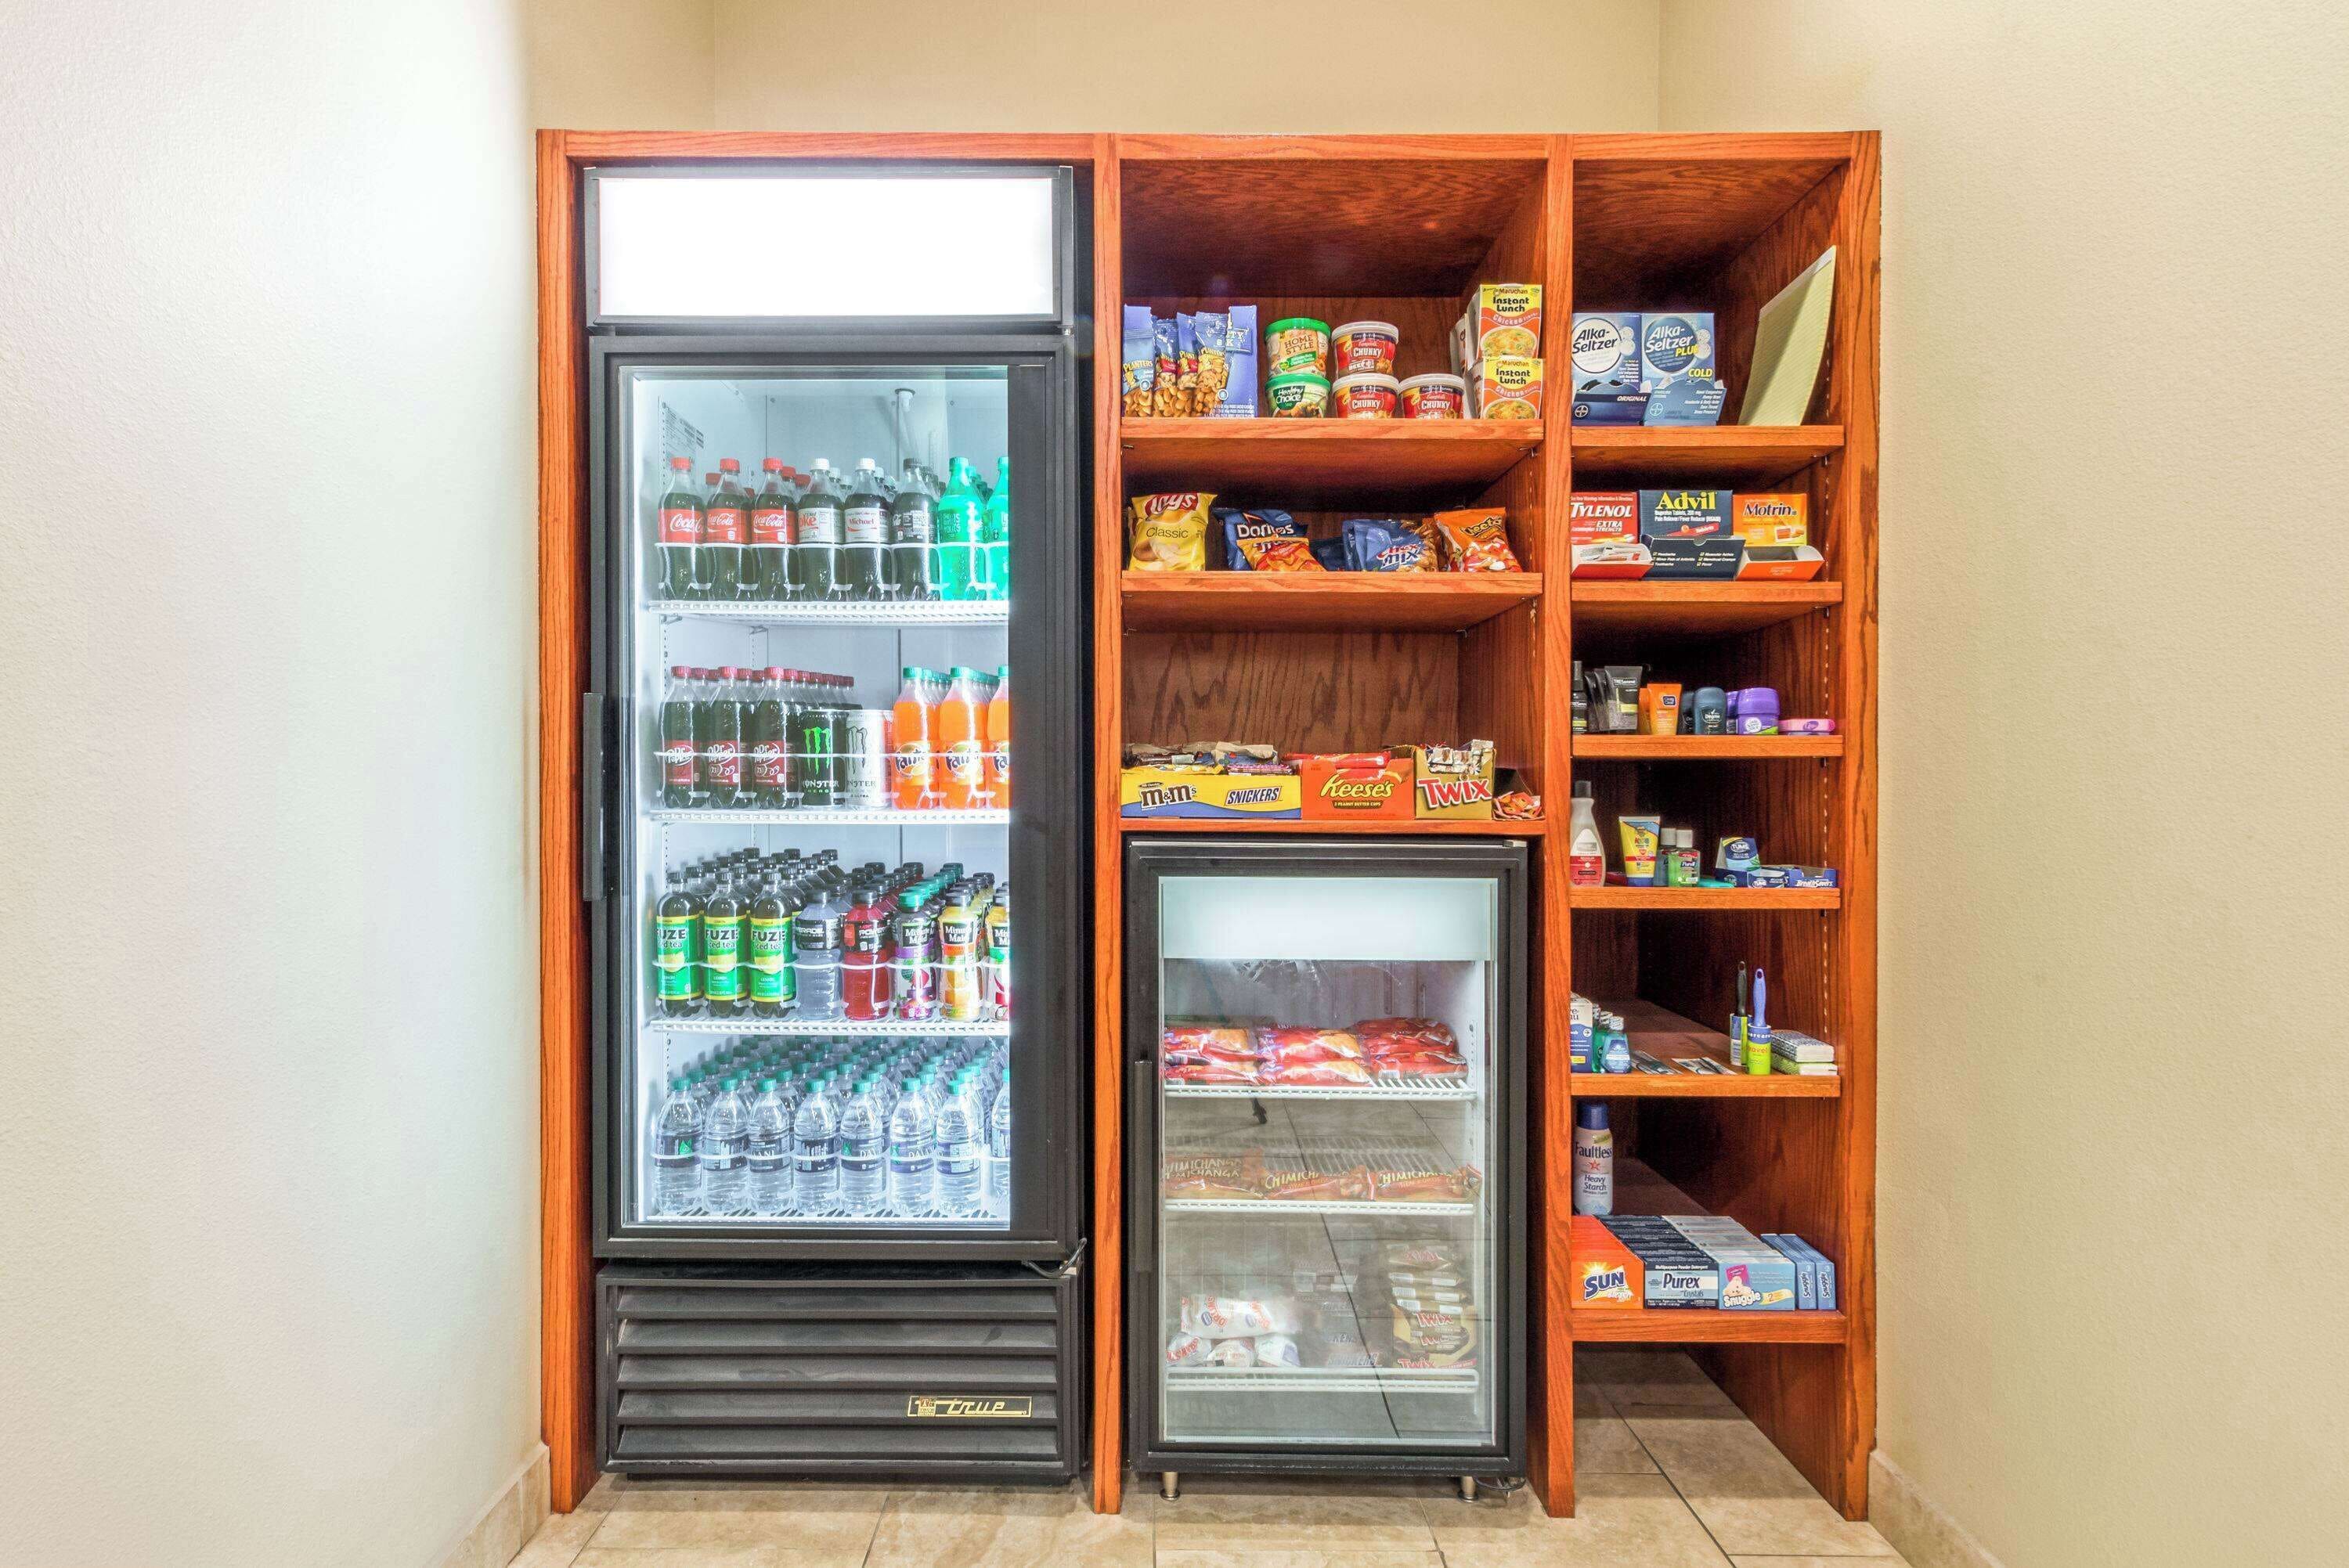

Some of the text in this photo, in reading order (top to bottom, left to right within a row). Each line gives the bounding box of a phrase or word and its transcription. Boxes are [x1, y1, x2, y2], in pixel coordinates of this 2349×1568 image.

[1492, 314, 1523, 326] Chicken
[1575, 328, 1610, 342] Alka-
[1649, 324, 1685, 340] Alka-
[1285, 334, 1313, 349] HOME
[1286, 341, 1314, 355] STYLE
[1572, 338, 1618, 354] Seltzer
[1645, 334, 1694, 353] Seltzer
[1353, 348, 1382, 358] CHUNKY
[1675, 344, 1700, 357] PLUS
[1496, 368, 1531, 377] Instant
[1688, 368, 1713, 377] COLD
[1499, 377, 1527, 385] Lunch
[1278, 386, 1304, 395] Healthy
[1276, 394, 1301, 404] Choice
[1351, 399, 1380, 409] CHUNKY
[1421, 400, 1450, 409] CHUNKY
[1655, 492, 1716, 510] Advil
[1570, 502, 1633, 518] TYLENOL
[1742, 503, 1792, 516] Motrin
[1146, 526, 1189, 539] Classic
[1237, 524, 1294, 538] Doritos
[1319, 773, 1394, 798] Reese's
[1229, 789, 1280, 804] SNICKERS
[1417, 778, 1492, 809] TWIX
[705, 930, 738, 940] FUZE
[752, 930, 785, 943] FUZE
[1584, 1174, 1606, 1184] Heavy
[1584, 1182, 1607, 1191] Starch
[1584, 1271, 1625, 1299] SUN
[1662, 1273, 1701, 1289] Purex
[1801, 1273, 1811, 1297] Snuggle
[1820, 1272, 1831, 1297] Snuggle
[1723, 1290, 1761, 1307] Snuggle
[1416, 1313, 1454, 1327] TWIX
[1398, 1358, 1435, 1368] TWIX
